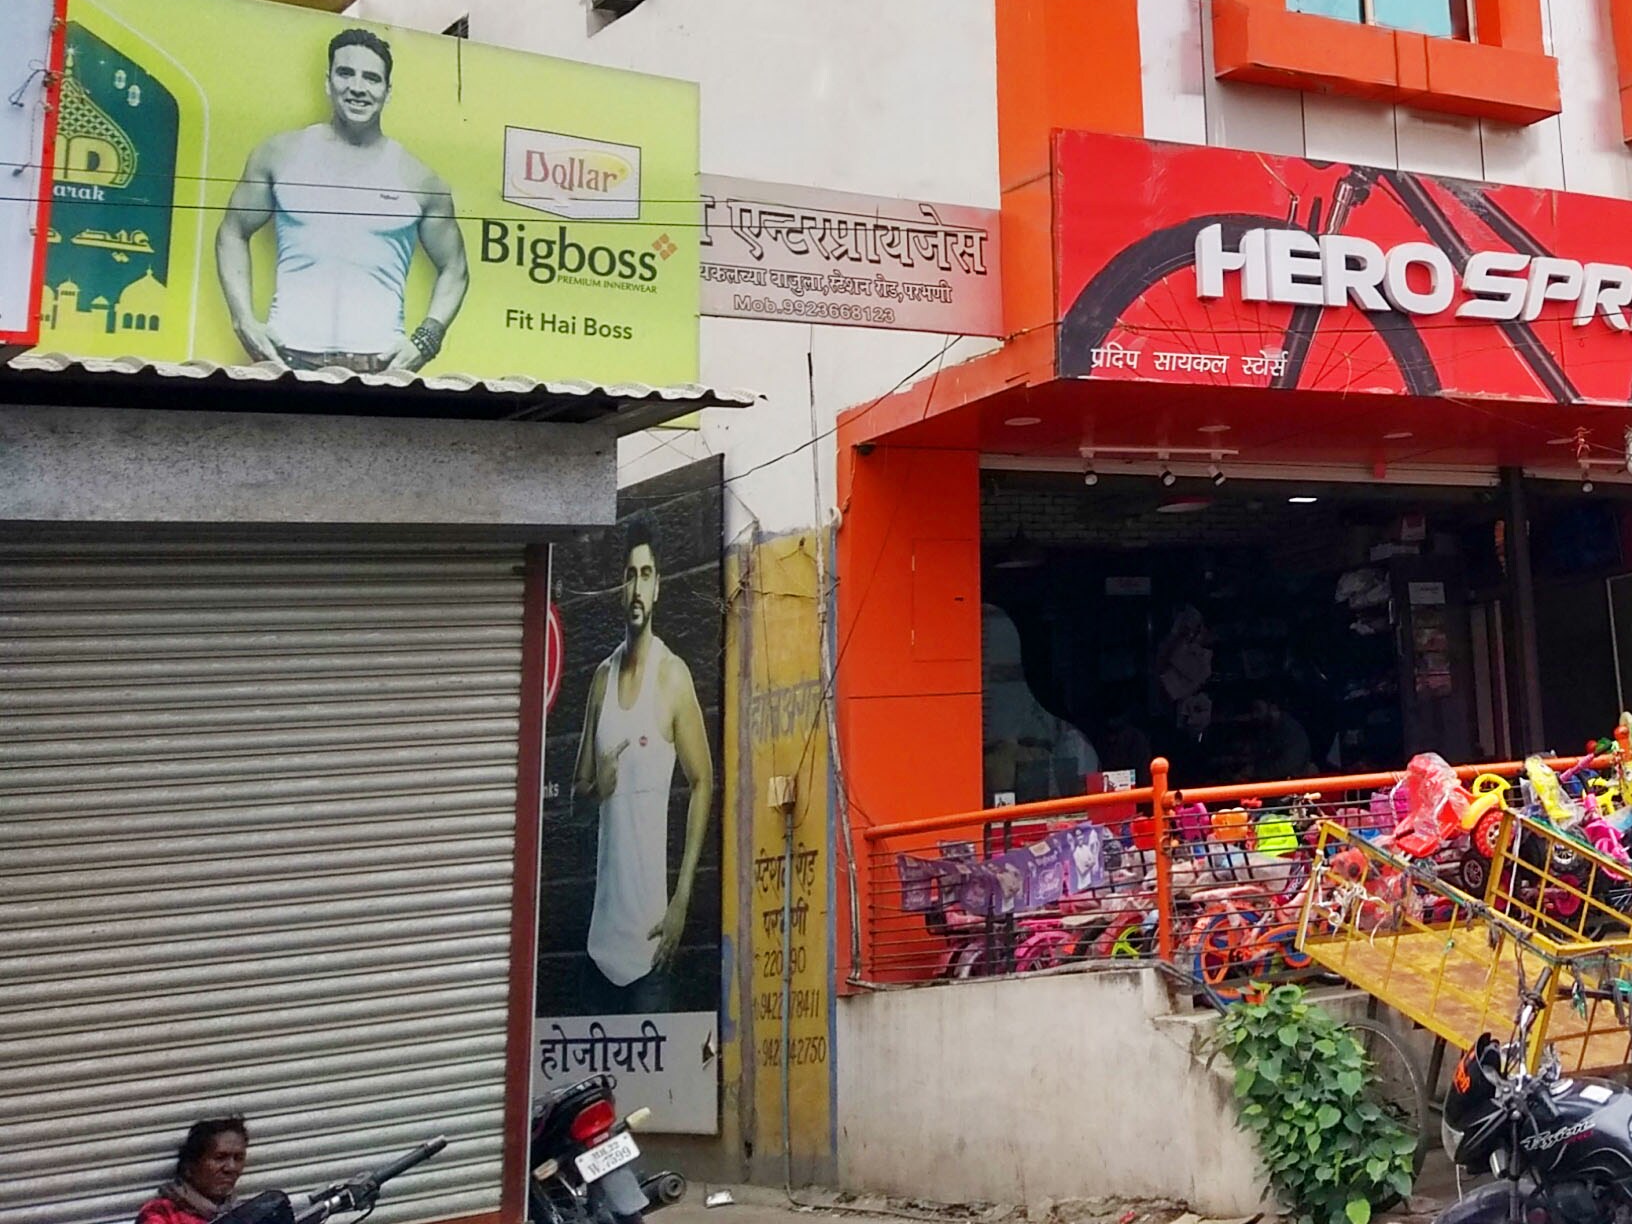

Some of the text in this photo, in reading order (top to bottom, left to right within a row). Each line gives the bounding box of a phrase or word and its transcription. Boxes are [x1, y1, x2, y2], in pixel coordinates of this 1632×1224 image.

[524, 150, 618, 192] Dollar
[480, 219, 658, 284] Bigboss
[1195, 223, 1455, 316] HERO
[557, 275, 658, 293] PREMIUM INNERWEAR
[506, 309, 633, 340] Fit Hai Boss
[1090, 342, 1288, 377] प्रदिप सायकल स्टोर्स
[539, 1020, 667, 1080] होजीयरी
